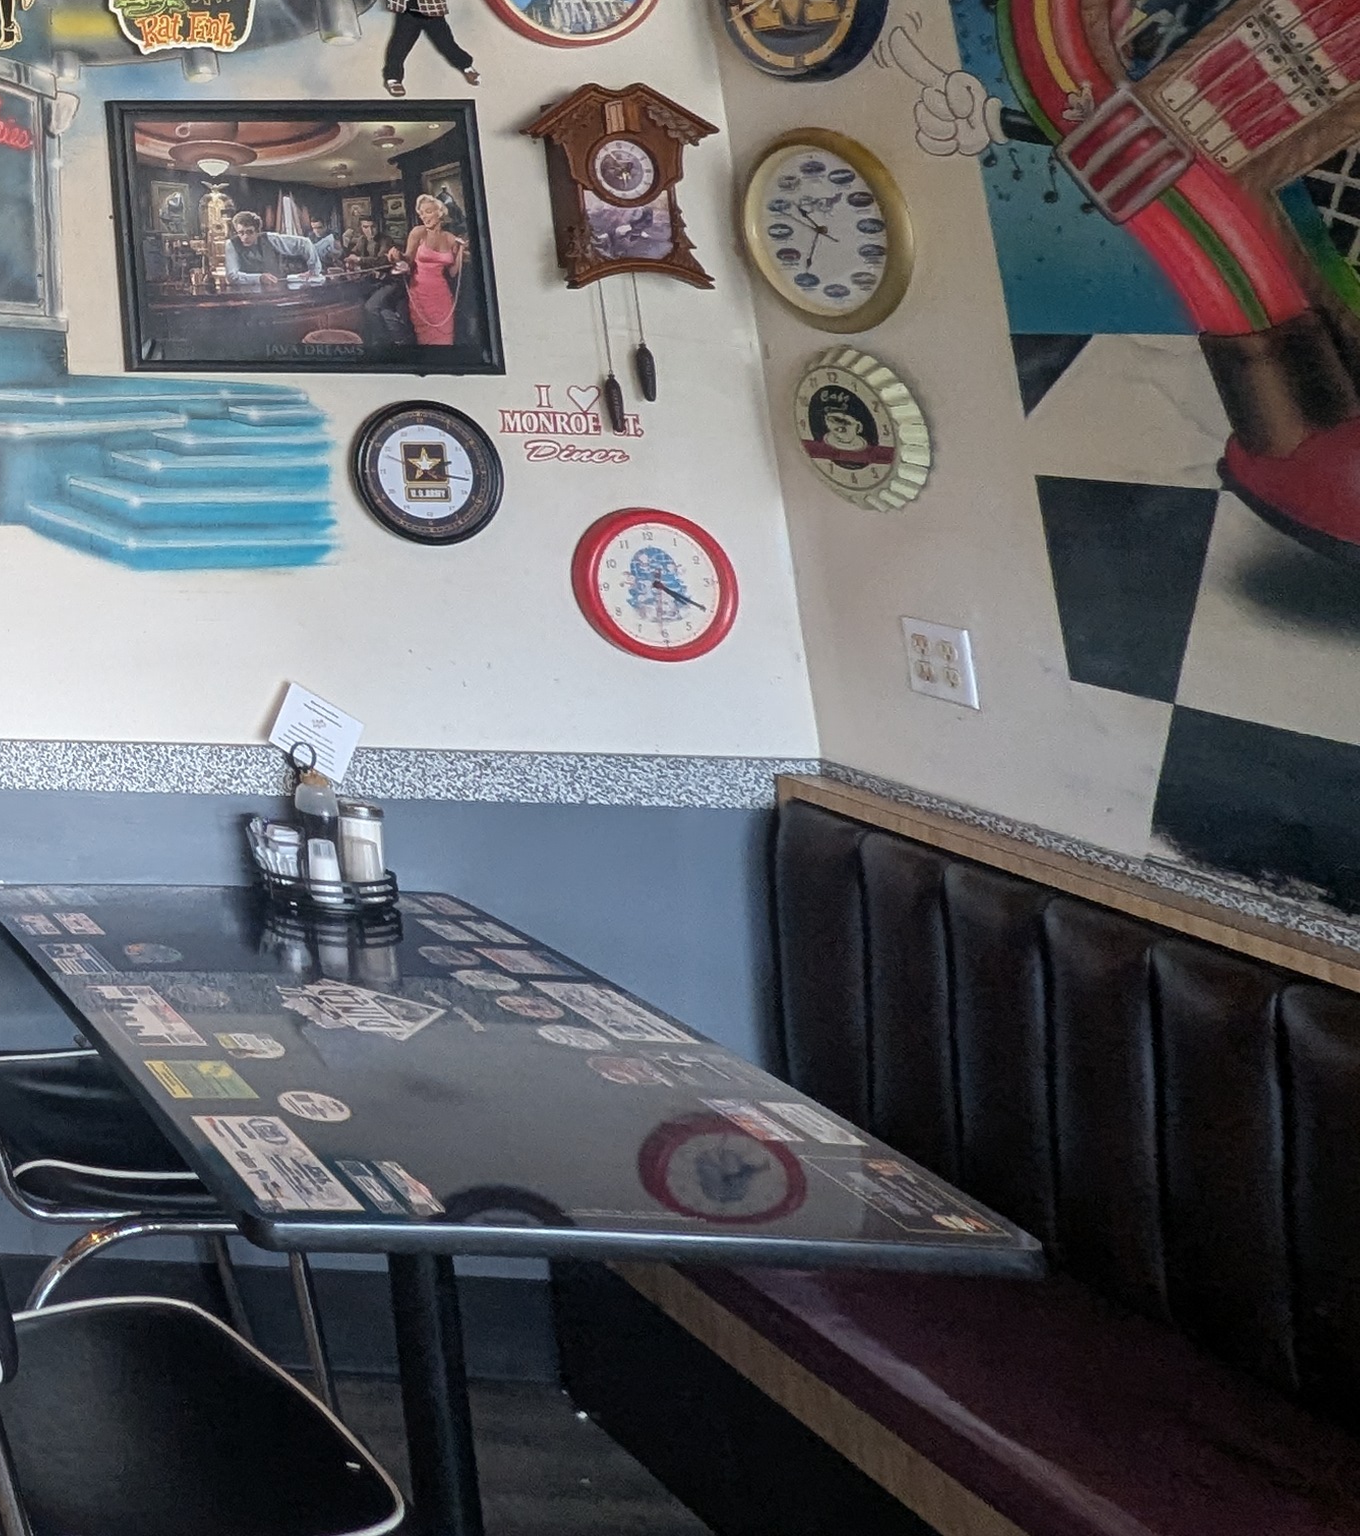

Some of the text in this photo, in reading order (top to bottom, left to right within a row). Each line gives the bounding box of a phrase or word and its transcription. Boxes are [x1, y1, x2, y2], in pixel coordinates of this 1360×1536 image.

[134, 11, 235, 48] Rat Fink
[536, 385, 553, 408] I
[499, 410, 644, 436] MONROE T.
[524, 440, 630, 464] Diner
[642, 532, 653, 540] 12
